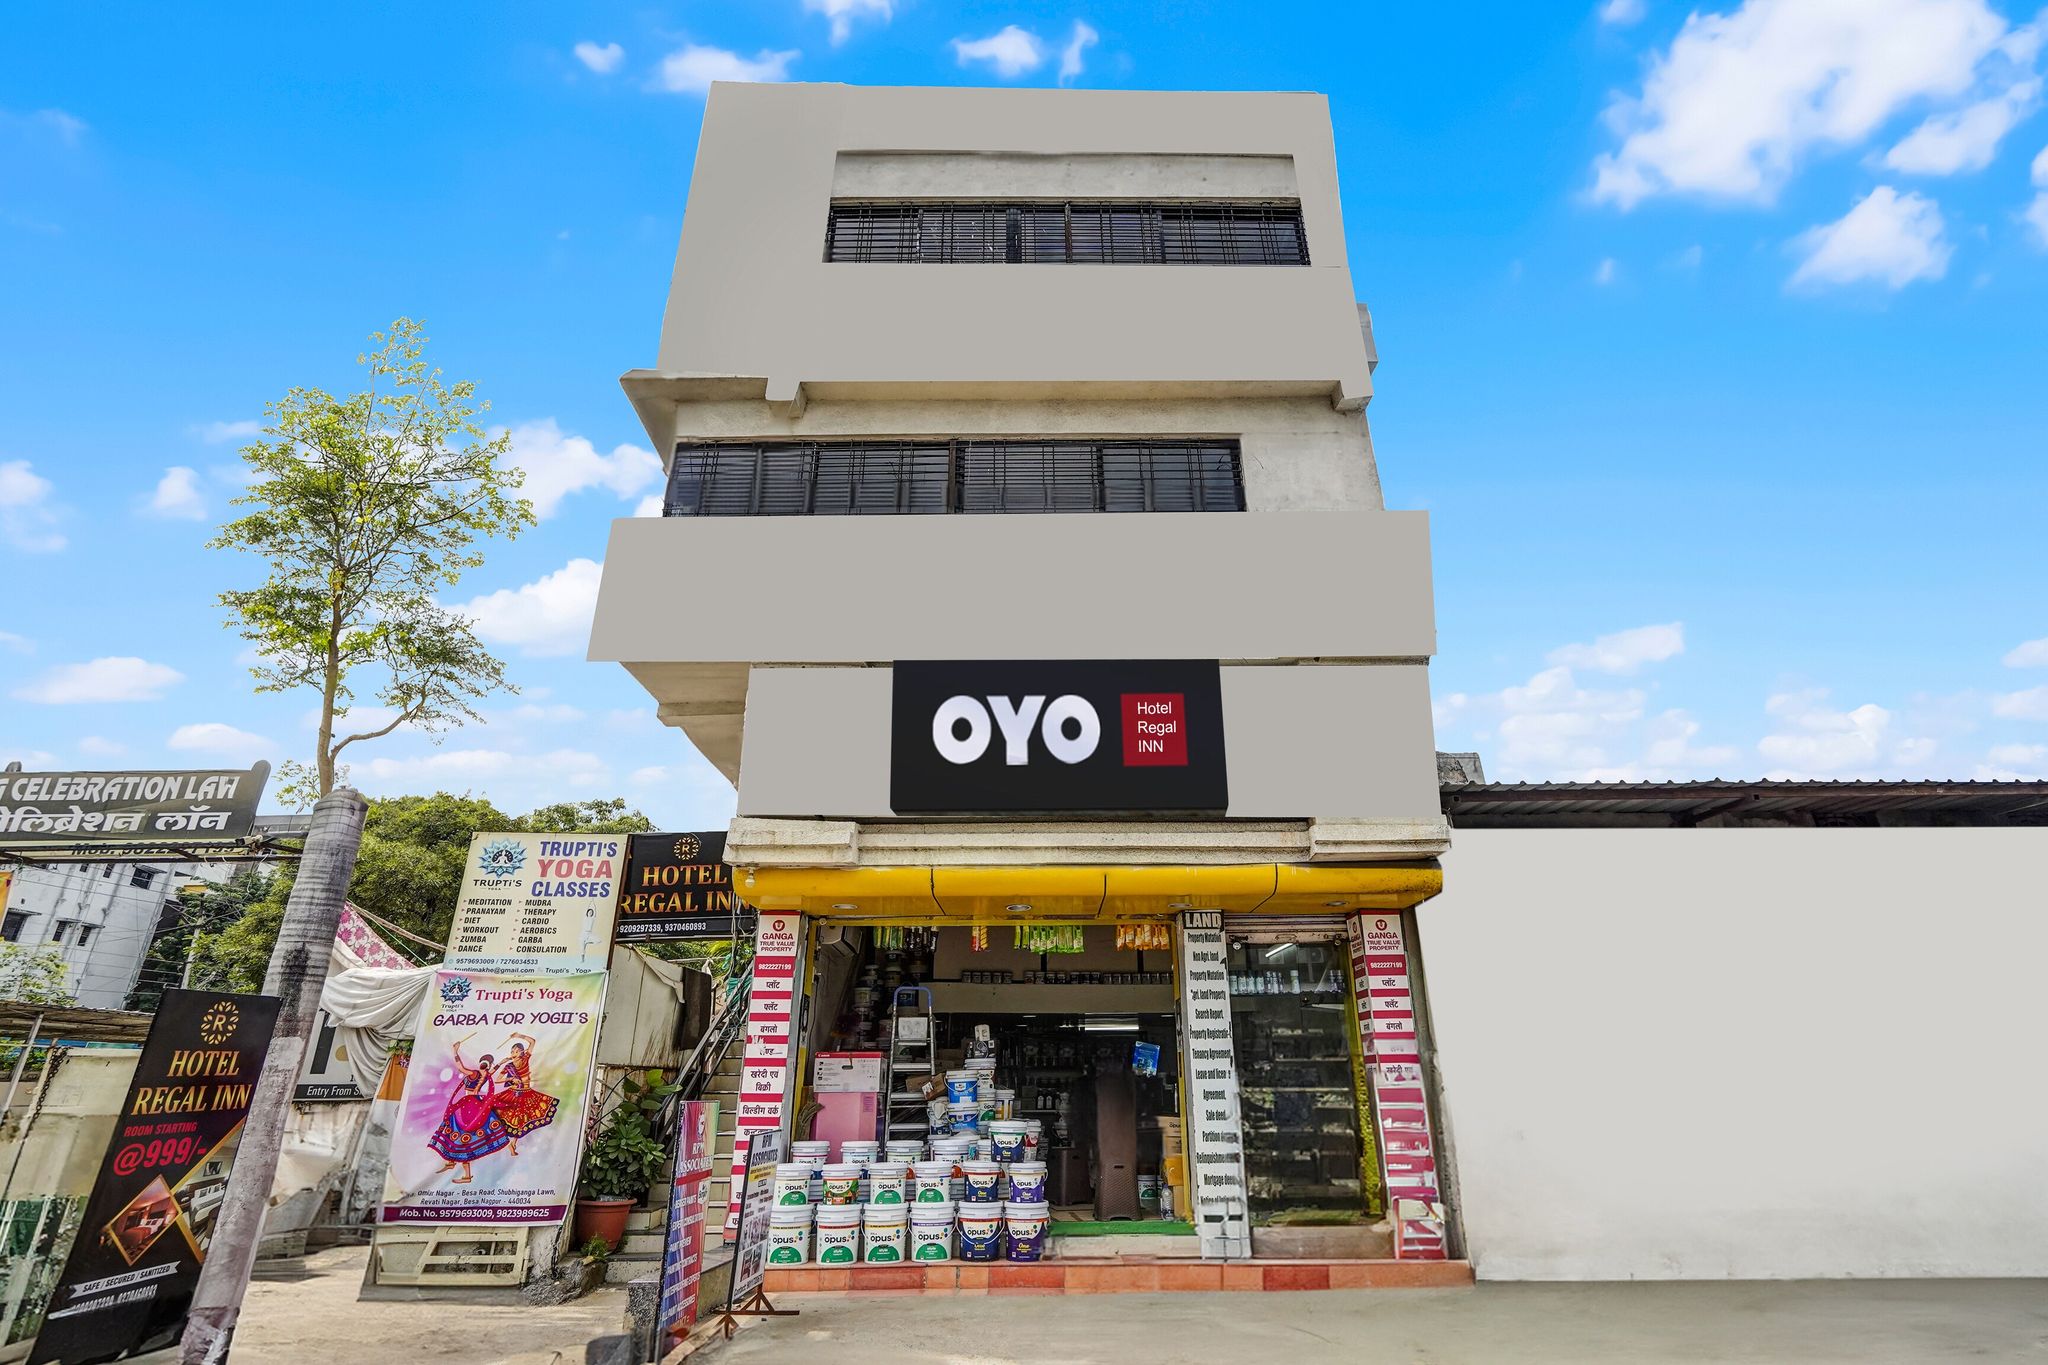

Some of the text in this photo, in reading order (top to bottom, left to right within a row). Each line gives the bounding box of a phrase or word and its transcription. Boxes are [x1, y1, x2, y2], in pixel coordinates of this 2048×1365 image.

[1137, 702, 1172, 715] Hotel
[932, 694, 1101, 766] OYO
[1137, 721, 1177, 736] Regal
[1138, 740, 1164, 753] INN
[11, 776, 184, 803] CELEBRATION
[156, 804, 233, 831] लॉन
[540, 841, 618, 858] TRUPTI'S
[537, 859, 613, 879] YOGA
[641, 864, 728, 887] HOTEL
[531, 881, 611, 898] CLASSES
[524, 899, 552, 907] MUDRA
[620, 891, 699, 914] REGAL
[523, 908, 557, 916] THERAPY
[521, 917, 550, 925] CARDIO
[1184, 912, 1222, 928] LAND
[462, 926, 500, 934] WORKOUT
[519, 927, 558, 935] AEROBICS
[665, 922, 707, 932] 9370460893
[518, 936, 543, 944] GARBA
[762, 932, 794, 941] GANGA
[1367, 931, 1399, 940] GANGA
[475, 988, 574, 1003] Trupti's Yoga
[433, 1013, 489, 1026] GARBA
[494, 1013, 526, 1025] FOR
[167, 1050, 240, 1078] HOTEL
[1195, 1068, 1207, 1080] Leave
[1207, 1068, 1216, 1080] and
[306, 1085, 330, 1098] Entry
[330, 1085, 352, 1096] From
[131, 1083, 253, 1116] REGAL INN
[1205, 1109, 1215, 1121] Sale
[123, 1121, 199, 1138] ROOM STARTING
[435, 1190, 455, 1198] Nagar
[399, 1209, 421, 1217] Mob.
[423, 1209, 438, 1217] No.
[496, 1208, 550, 1218] 9823989625
[82, 1265, 171, 1293] SAFE SECURED SANITIZED
